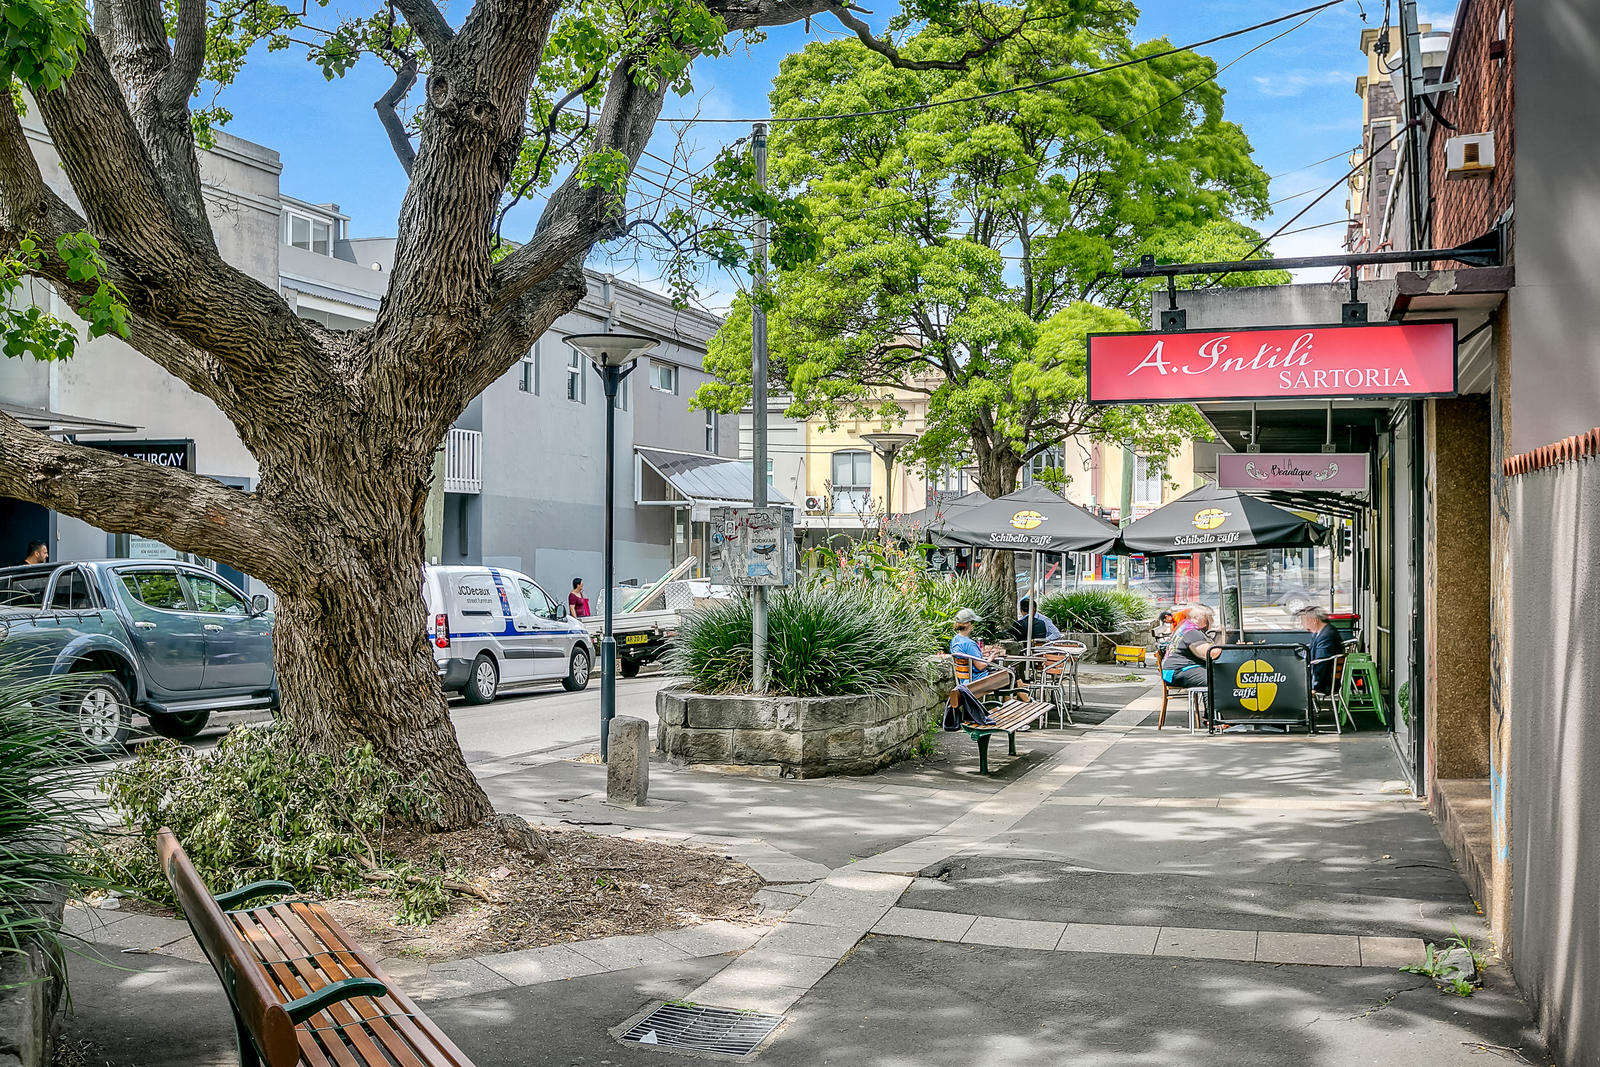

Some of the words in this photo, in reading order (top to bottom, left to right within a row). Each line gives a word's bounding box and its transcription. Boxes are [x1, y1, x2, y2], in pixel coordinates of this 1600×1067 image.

[1279, 367, 1411, 389] SARTORIA
[1282, 458, 1293, 470] LA
[990, 533, 1029, 543] Schibello
[1030, 535, 1052, 546] caffé
[1174, 533, 1216, 546] Schibello
[1216, 531, 1240, 544] caffé
[457, 585, 491, 596] JCDecaux
[1241, 673, 1286, 682] Schibello
[1232, 687, 1257, 699] caffé
